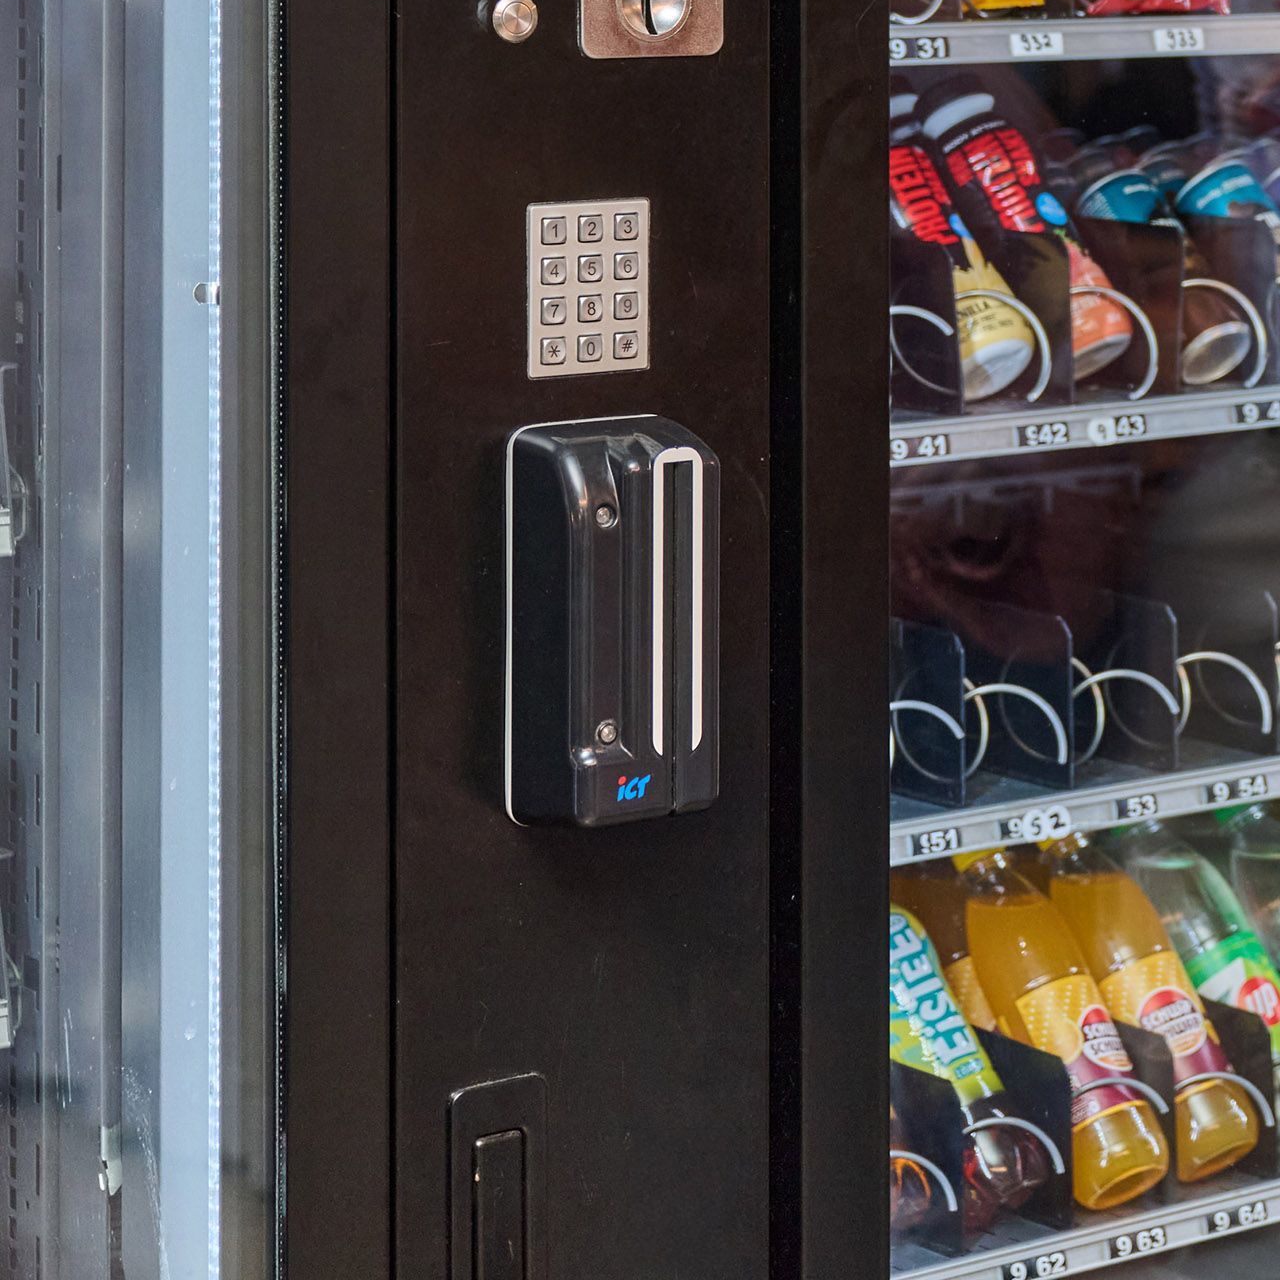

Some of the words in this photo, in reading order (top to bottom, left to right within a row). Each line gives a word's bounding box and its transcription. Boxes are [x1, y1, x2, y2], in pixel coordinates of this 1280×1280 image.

[917, 37, 947, 57] 31
[587, 222, 597, 236] 2
[623, 220, 633, 234] 3
[550, 264, 560, 278] 4
[587, 261, 596, 276] 5
[623, 259, 632, 274] 6
[551, 304, 560, 319] 7
[587, 301, 596, 316] 8
[623, 299, 632, 313] 9
[586, 341, 595, 356] 0
[918, 436, 948, 456] 41
[1238, 775, 1268, 797] 54
[1213, 1212, 1230, 1232] 9
[1238, 1201, 1268, 1224] 64
[1116, 1236, 1132, 1257] 9
[1136, 1227, 1166, 1251] 63
[1035, 1252, 1067, 1275] 62
